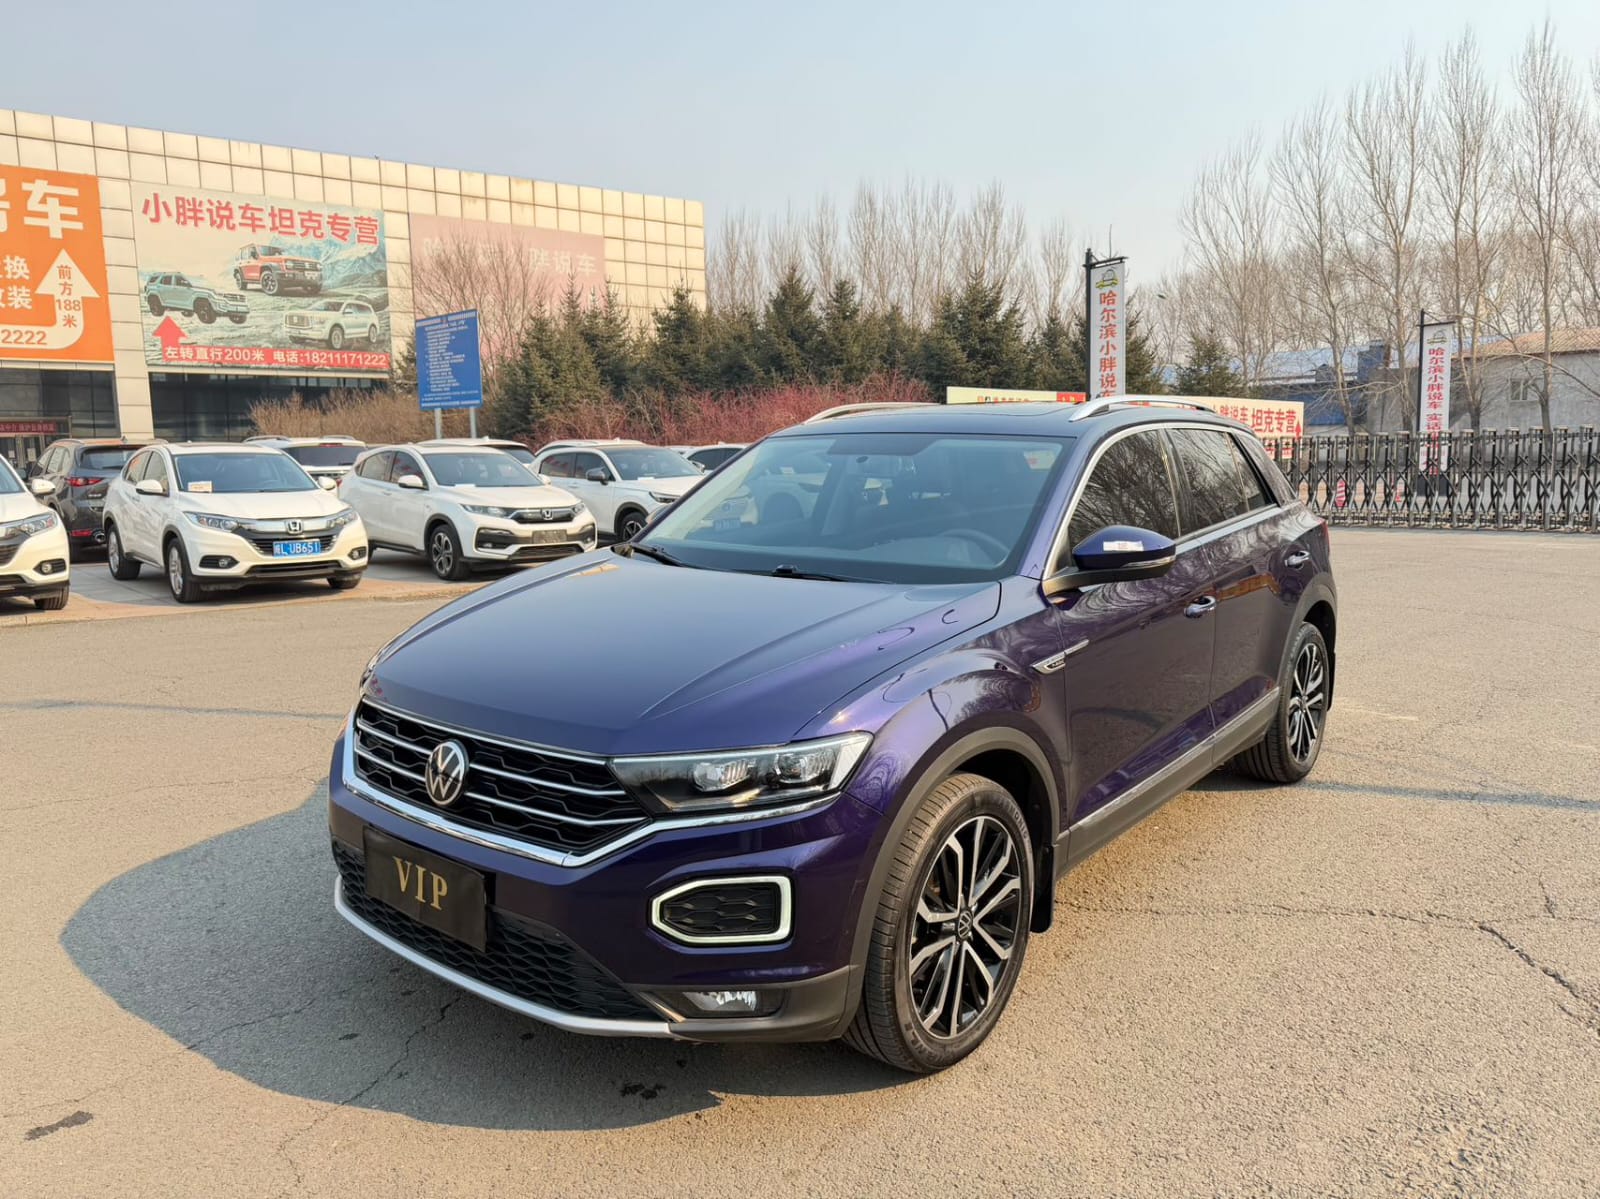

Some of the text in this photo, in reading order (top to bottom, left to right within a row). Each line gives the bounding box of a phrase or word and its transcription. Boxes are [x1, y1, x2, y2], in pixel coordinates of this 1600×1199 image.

[0, 177, 84, 239] 车
[142, 192, 379, 245] 小胖说车坦克专营
[0, 255, 30, 281] 换
[0, 286, 33, 311] 装
[165, 346, 265, 363] 左转直行200米
[392, 855, 449, 911] VIP
